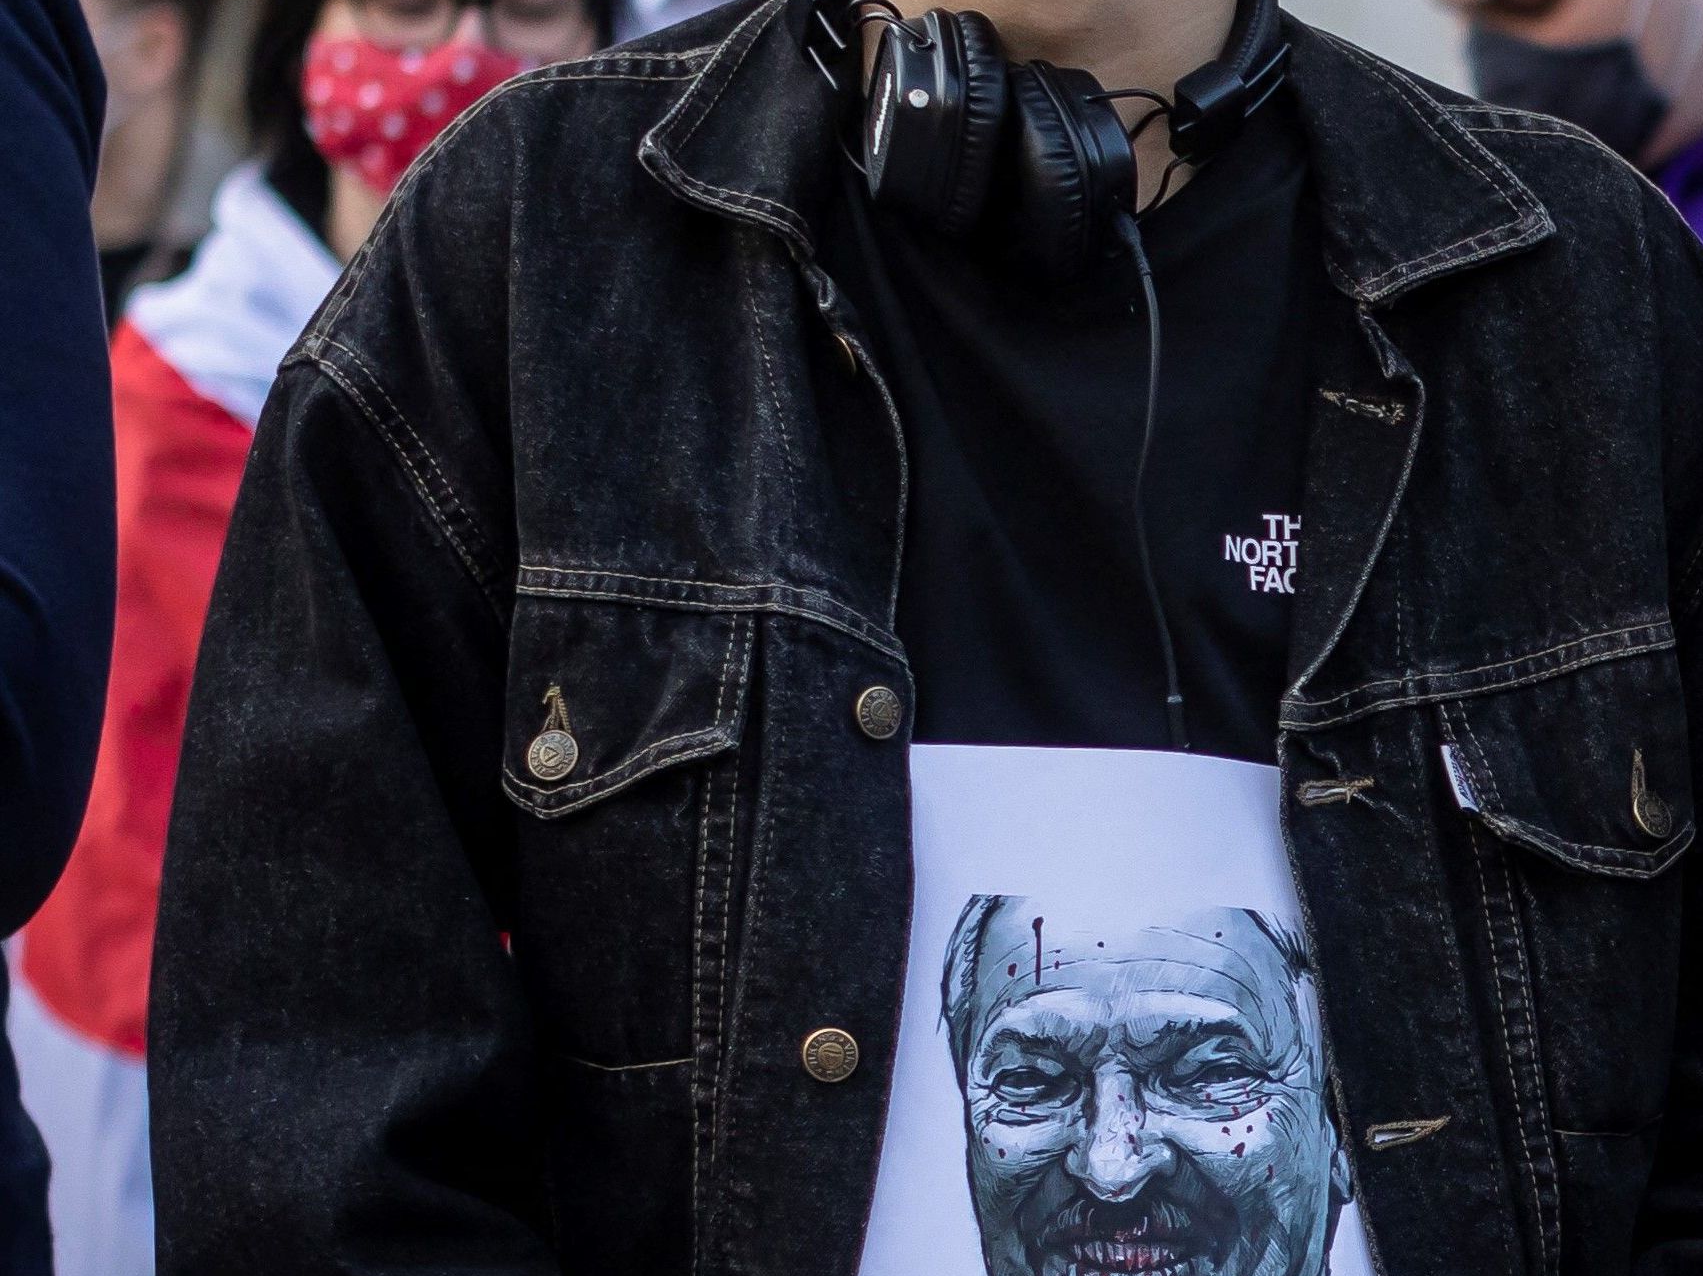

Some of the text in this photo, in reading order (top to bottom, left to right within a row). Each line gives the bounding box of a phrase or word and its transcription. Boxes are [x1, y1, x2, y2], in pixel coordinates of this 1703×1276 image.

[1262, 513, 1301, 540] TH
[1224, 534, 1299, 567] NORT
[1250, 566, 1297, 594] FAC
